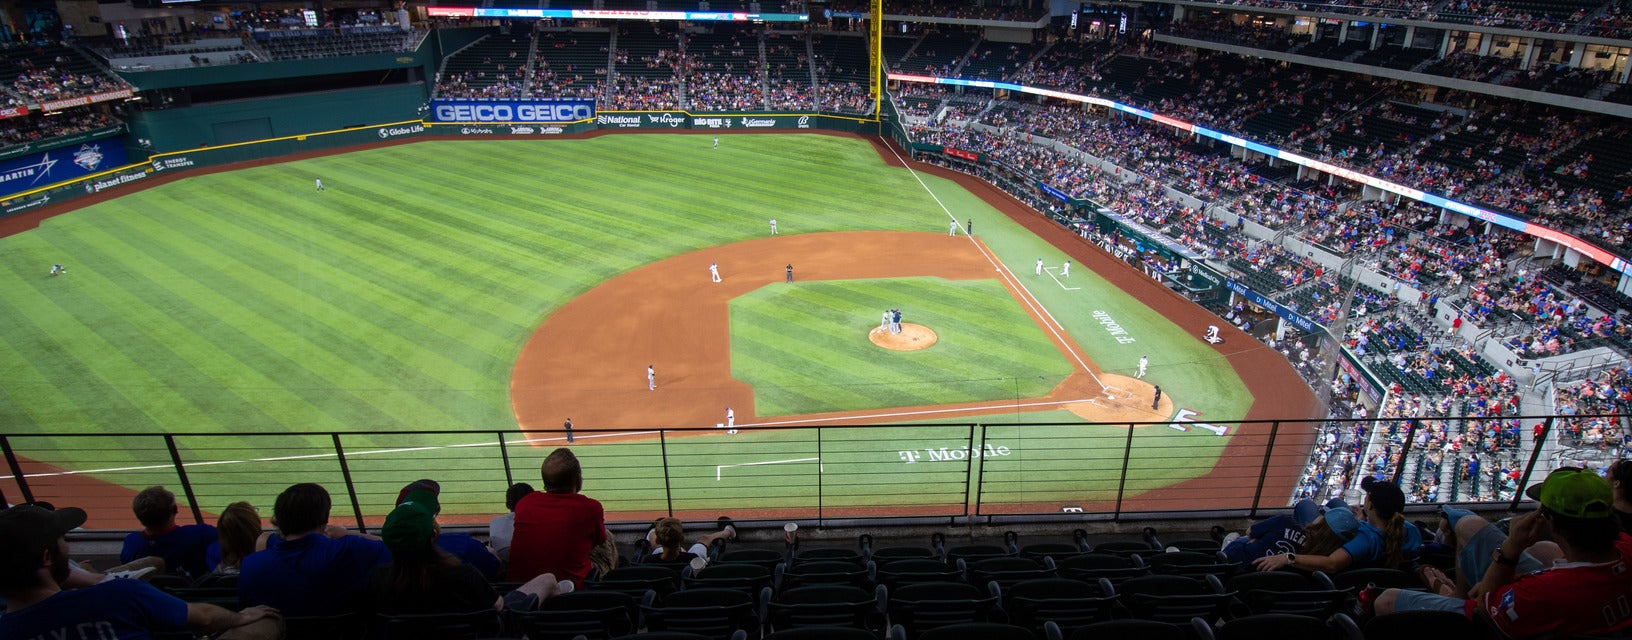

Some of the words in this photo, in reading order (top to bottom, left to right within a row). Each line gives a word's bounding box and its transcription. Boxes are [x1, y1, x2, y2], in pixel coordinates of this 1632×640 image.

[436, 104, 513, 121] GEICO
[517, 104, 592, 121] GEICO
[607, 115, 641, 124] National
[660, 113, 685, 127] Kroger
[389, 126, 411, 136] Globe
[410, 125, 424, 133] Life
[164, 157, 187, 165] ENERGY
[166, 160, 194, 168] TRANSFER
[0, 168, 35, 183] MARTIN
[94, 177, 121, 193] planet
[121, 170, 147, 187] fitness
[1262, 299, 1278, 313] Mitel
[1092, 310, 1129, 335] Mobile
[1295, 316, 1313, 331] Mitel
[925, 443, 1011, 462] Mobile
